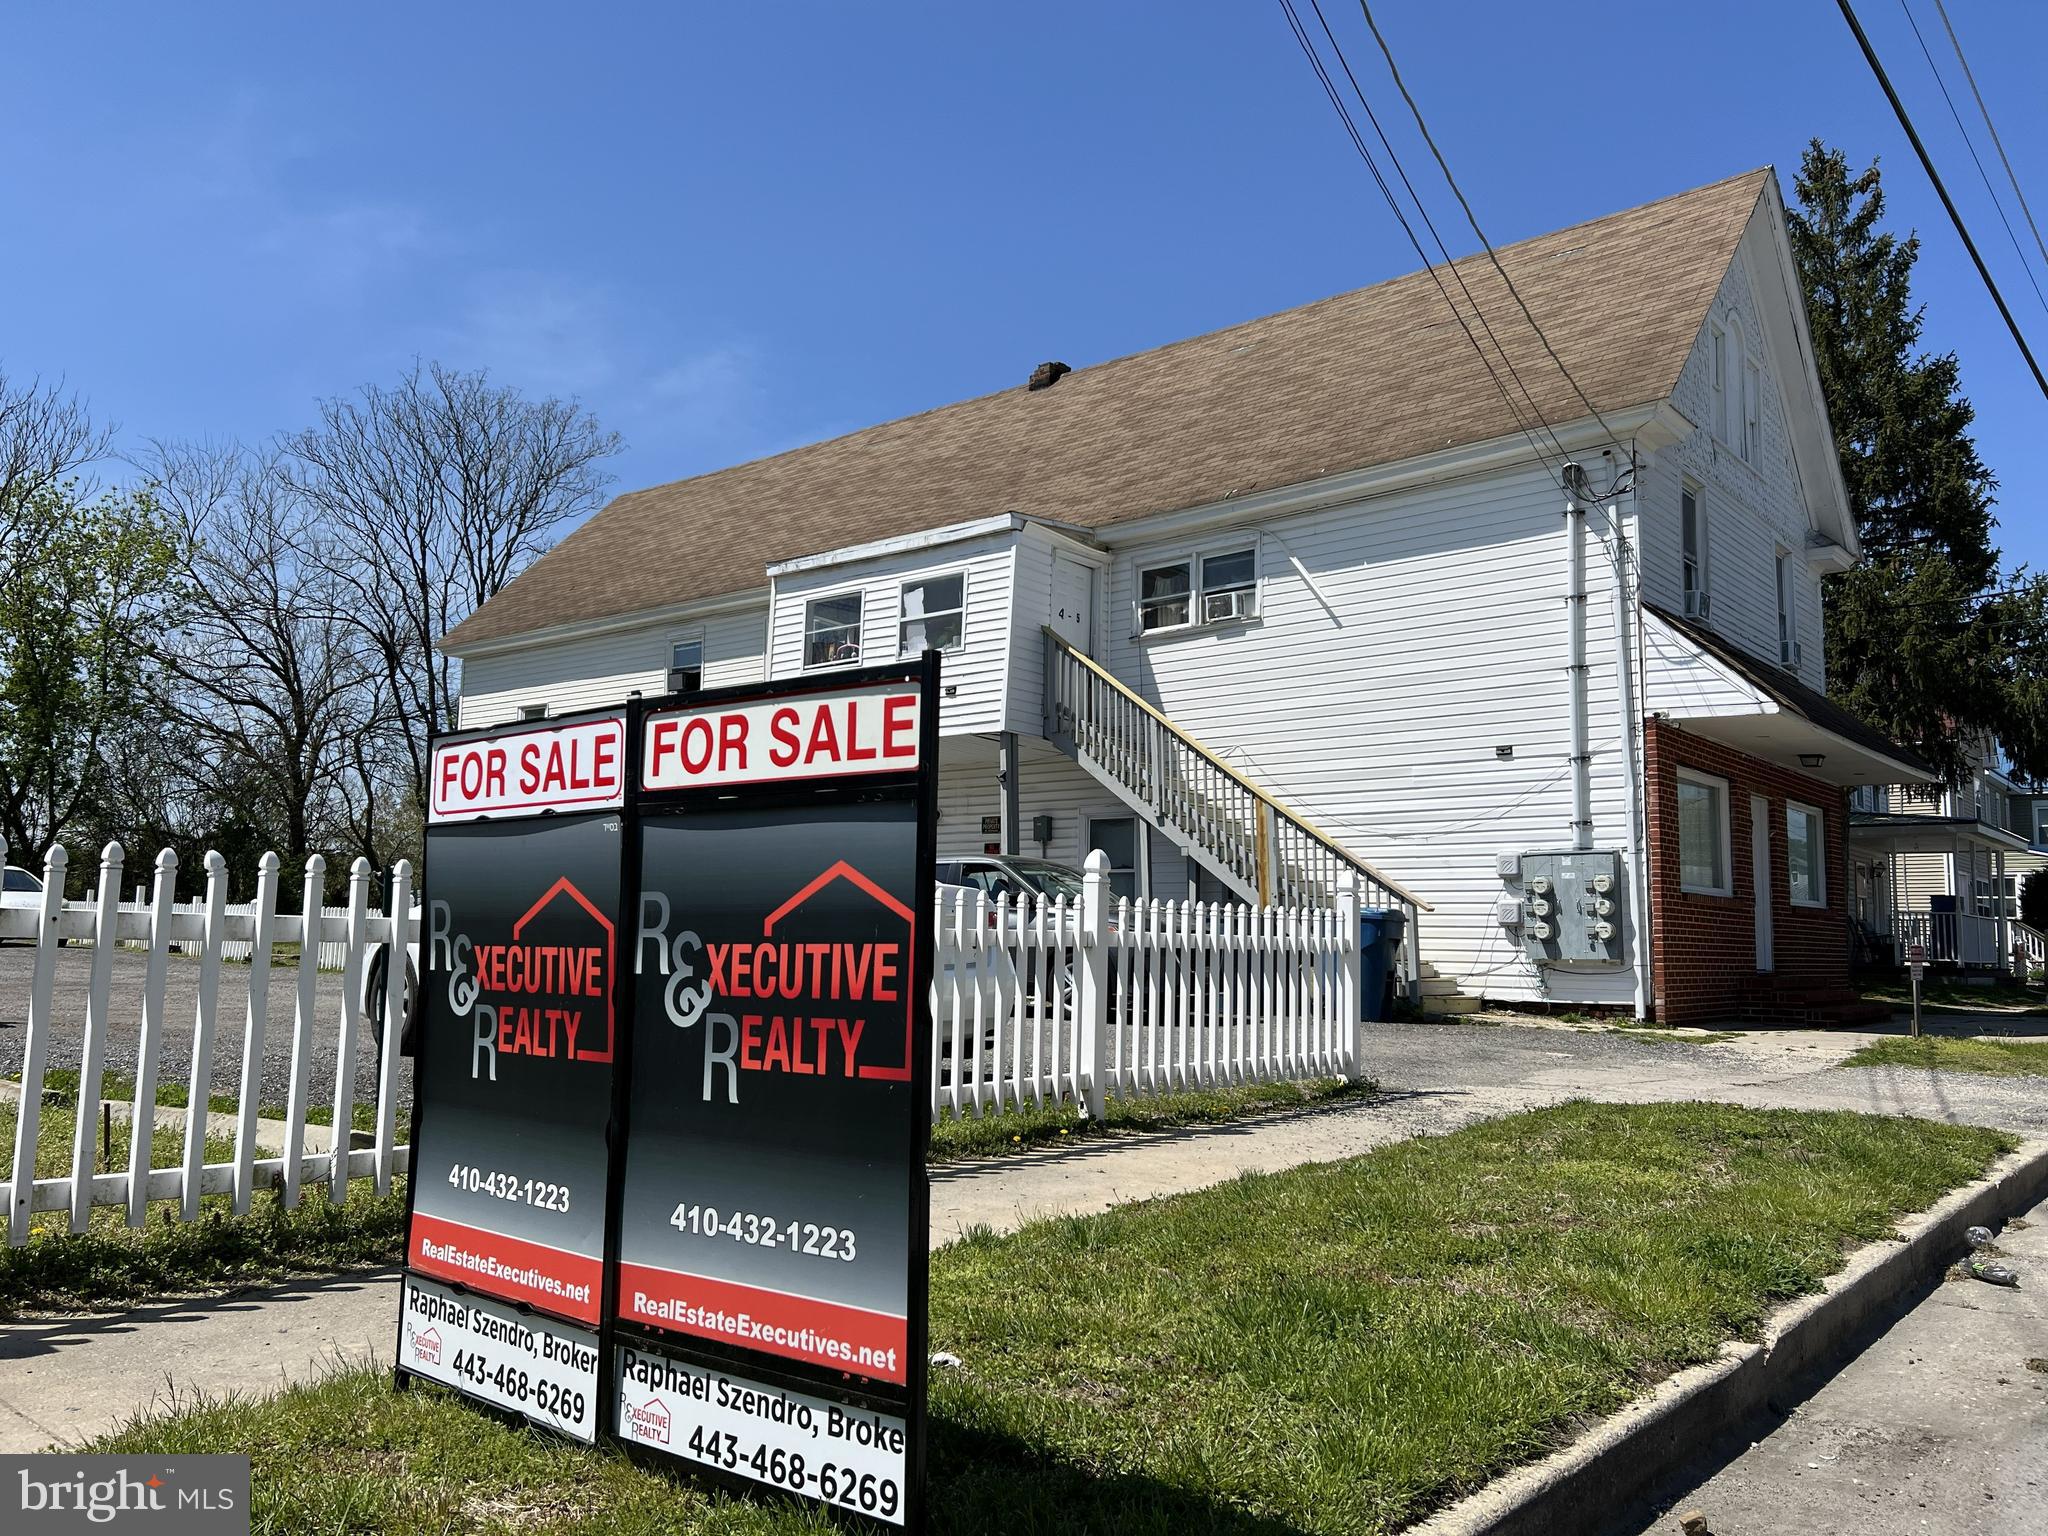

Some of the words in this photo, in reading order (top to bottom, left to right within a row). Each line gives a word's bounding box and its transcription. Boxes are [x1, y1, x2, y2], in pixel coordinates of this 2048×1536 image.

[1058, 607, 1064, 619] 4
[441, 748, 506, 801] FOR
[519, 733, 616, 794] SALE
[651, 713, 750, 777] FOR
[769, 695, 917, 768] SALE
[472, 1004, 582, 1081] REALTY
[703, 1012, 866, 1104] REALTY
[449, 1164, 570, 1213] 410-432-1223
[670, 1203, 856, 1261] 410-432-1223
[422, 1239, 590, 1304] RealEstateExecutives.net
[409, 1285, 469, 1329] Raphael
[473, 1308, 538, 1359] Szendro,
[543, 1332, 598, 1374] Broker
[634, 1291, 896, 1372] RealEstateExecutives.net
[453, 1349, 585, 1424] 443-468-6269
[623, 1350, 710, 1402] Raphael
[716, 1377, 818, 1438] Szendro,
[828, 1405, 905, 1454] Broke
[632, 1421, 661, 1441] REALTY
[689, 1425, 899, 1517] 443-468-6269
